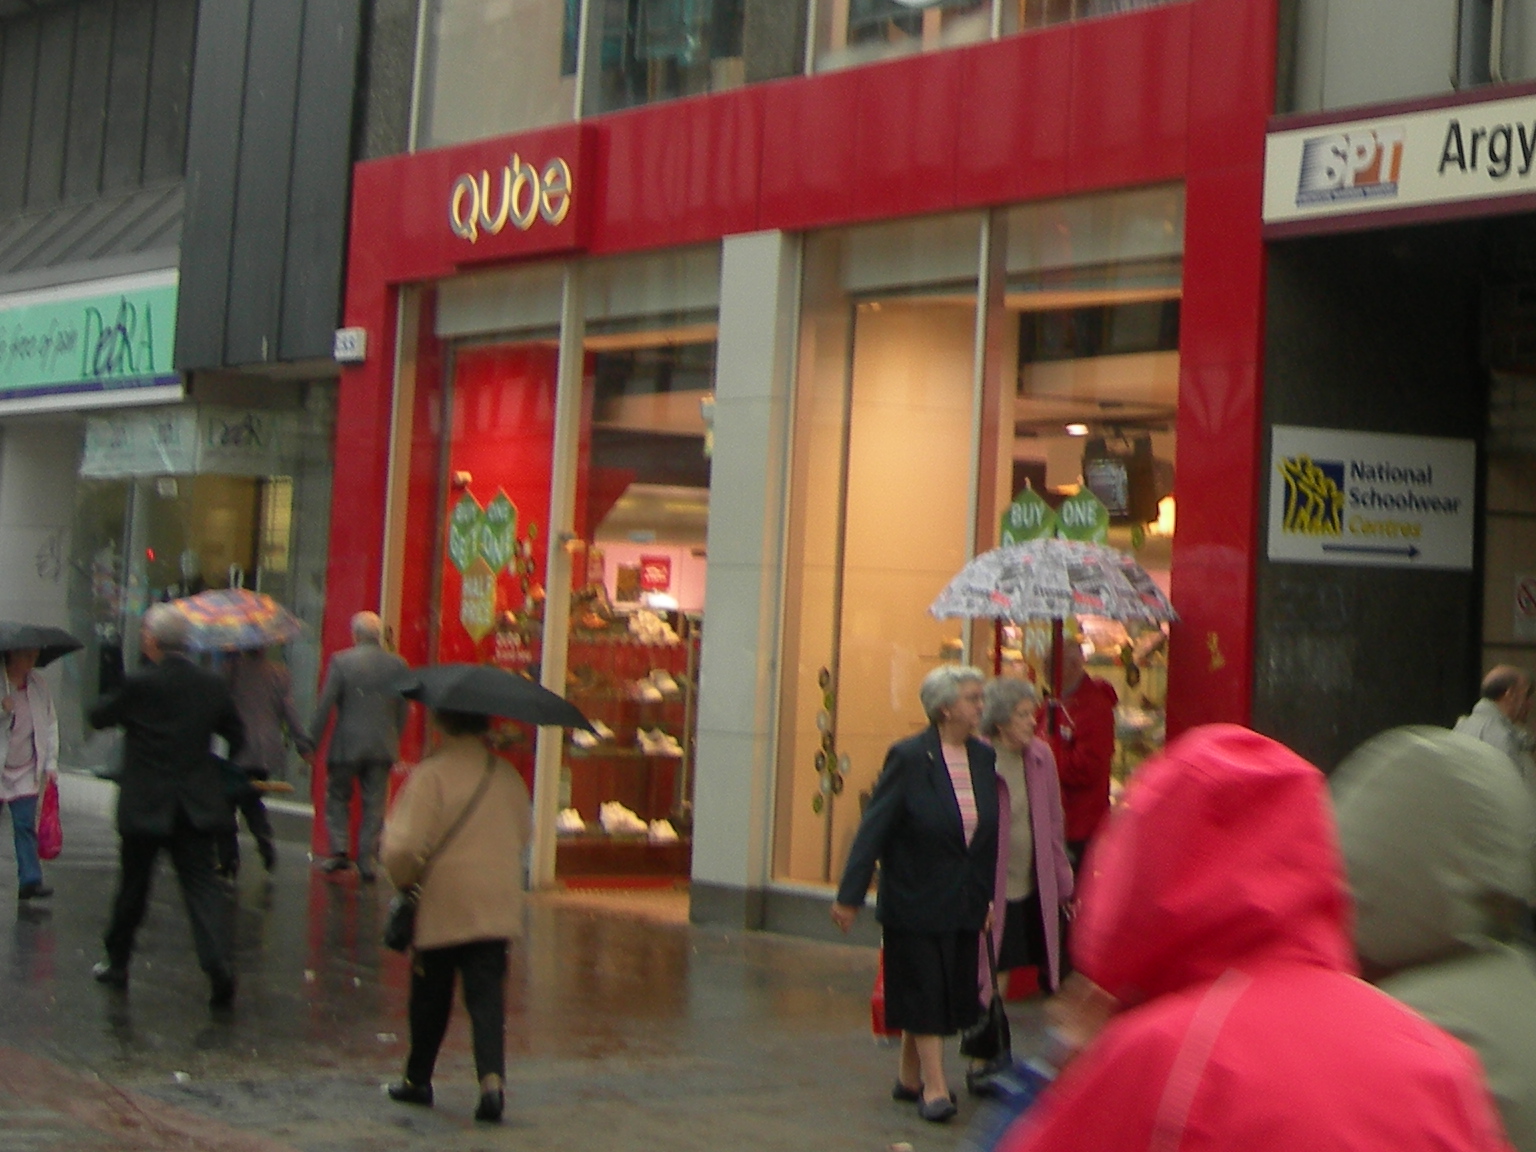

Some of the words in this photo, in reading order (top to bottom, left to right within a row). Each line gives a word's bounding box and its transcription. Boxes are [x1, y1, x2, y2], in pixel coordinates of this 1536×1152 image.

[1324, 129, 1405, 188] SPT
[1350, 459, 1433, 487] National
[1011, 501, 1045, 528] BUY
[1062, 499, 1097, 527] ONE
[1349, 486, 1461, 515] Schoolwear
